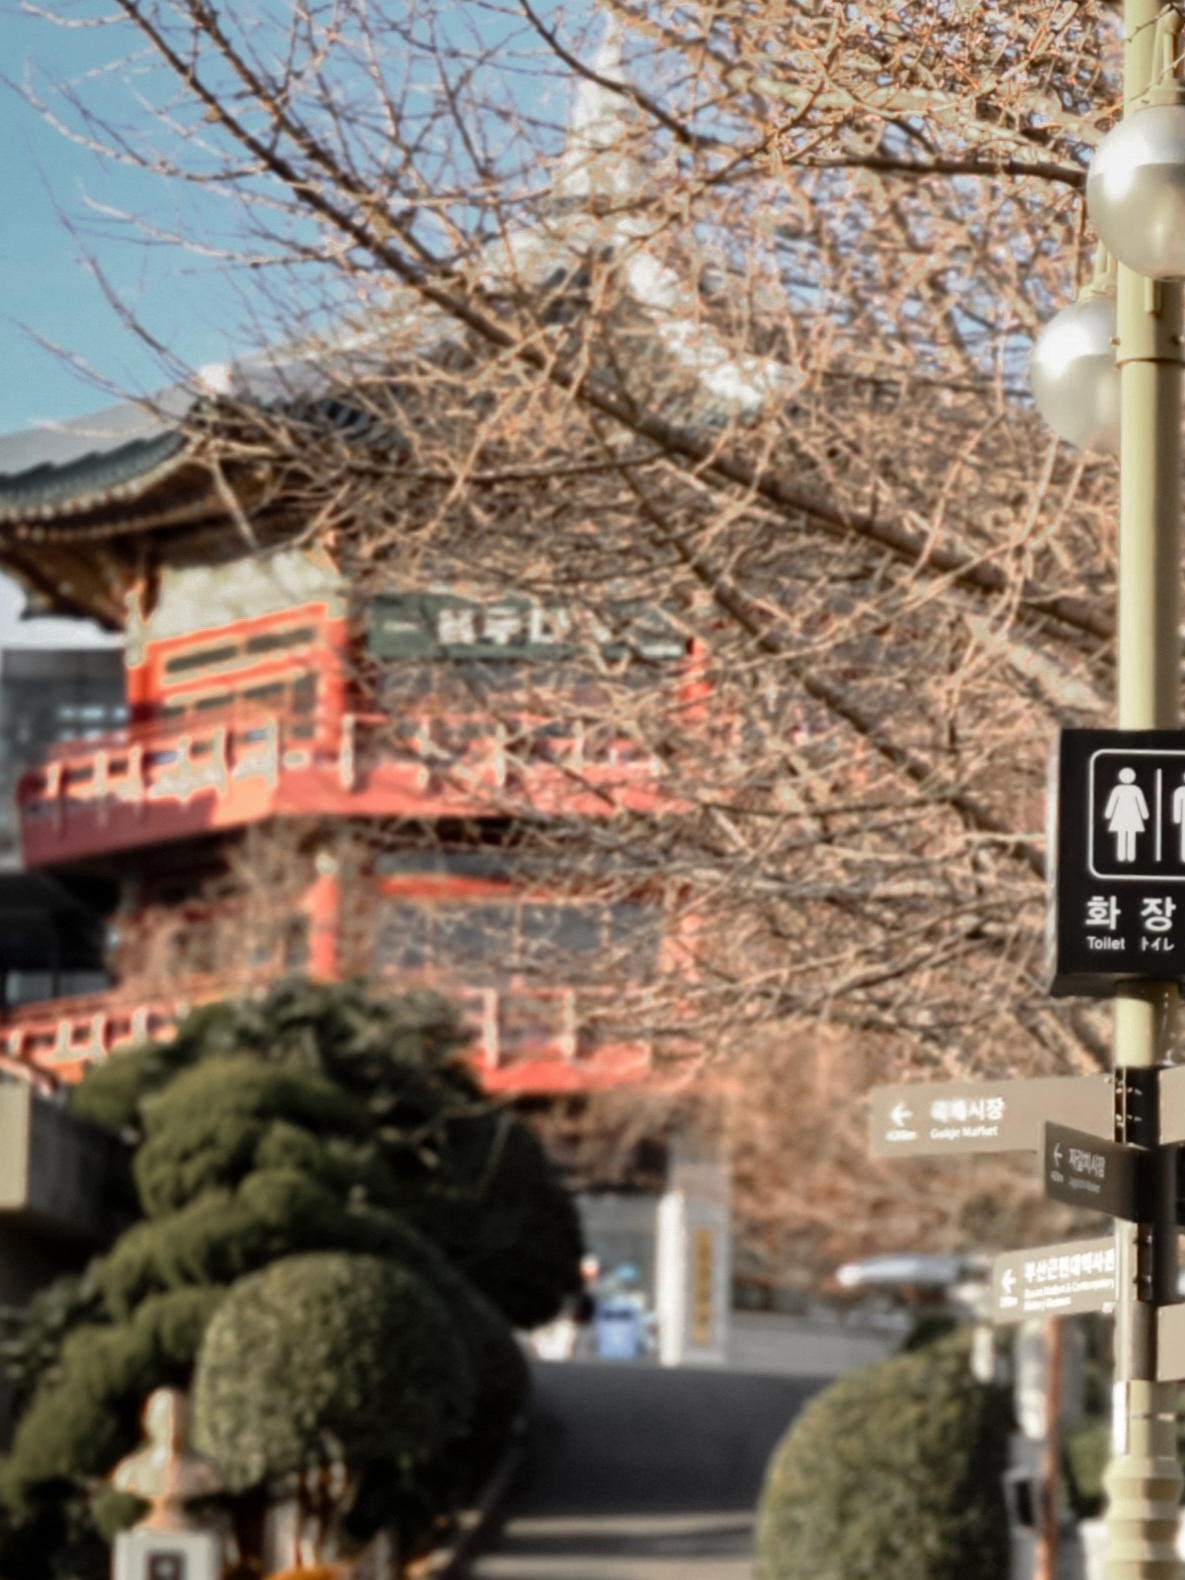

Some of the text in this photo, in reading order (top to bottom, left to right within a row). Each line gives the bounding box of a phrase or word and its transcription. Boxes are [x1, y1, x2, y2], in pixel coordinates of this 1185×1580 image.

[1087, 936, 1126, 950] Toilet
[1141, 936, 1175, 951] トイレ
[962, 1125, 998, 1138] Market
